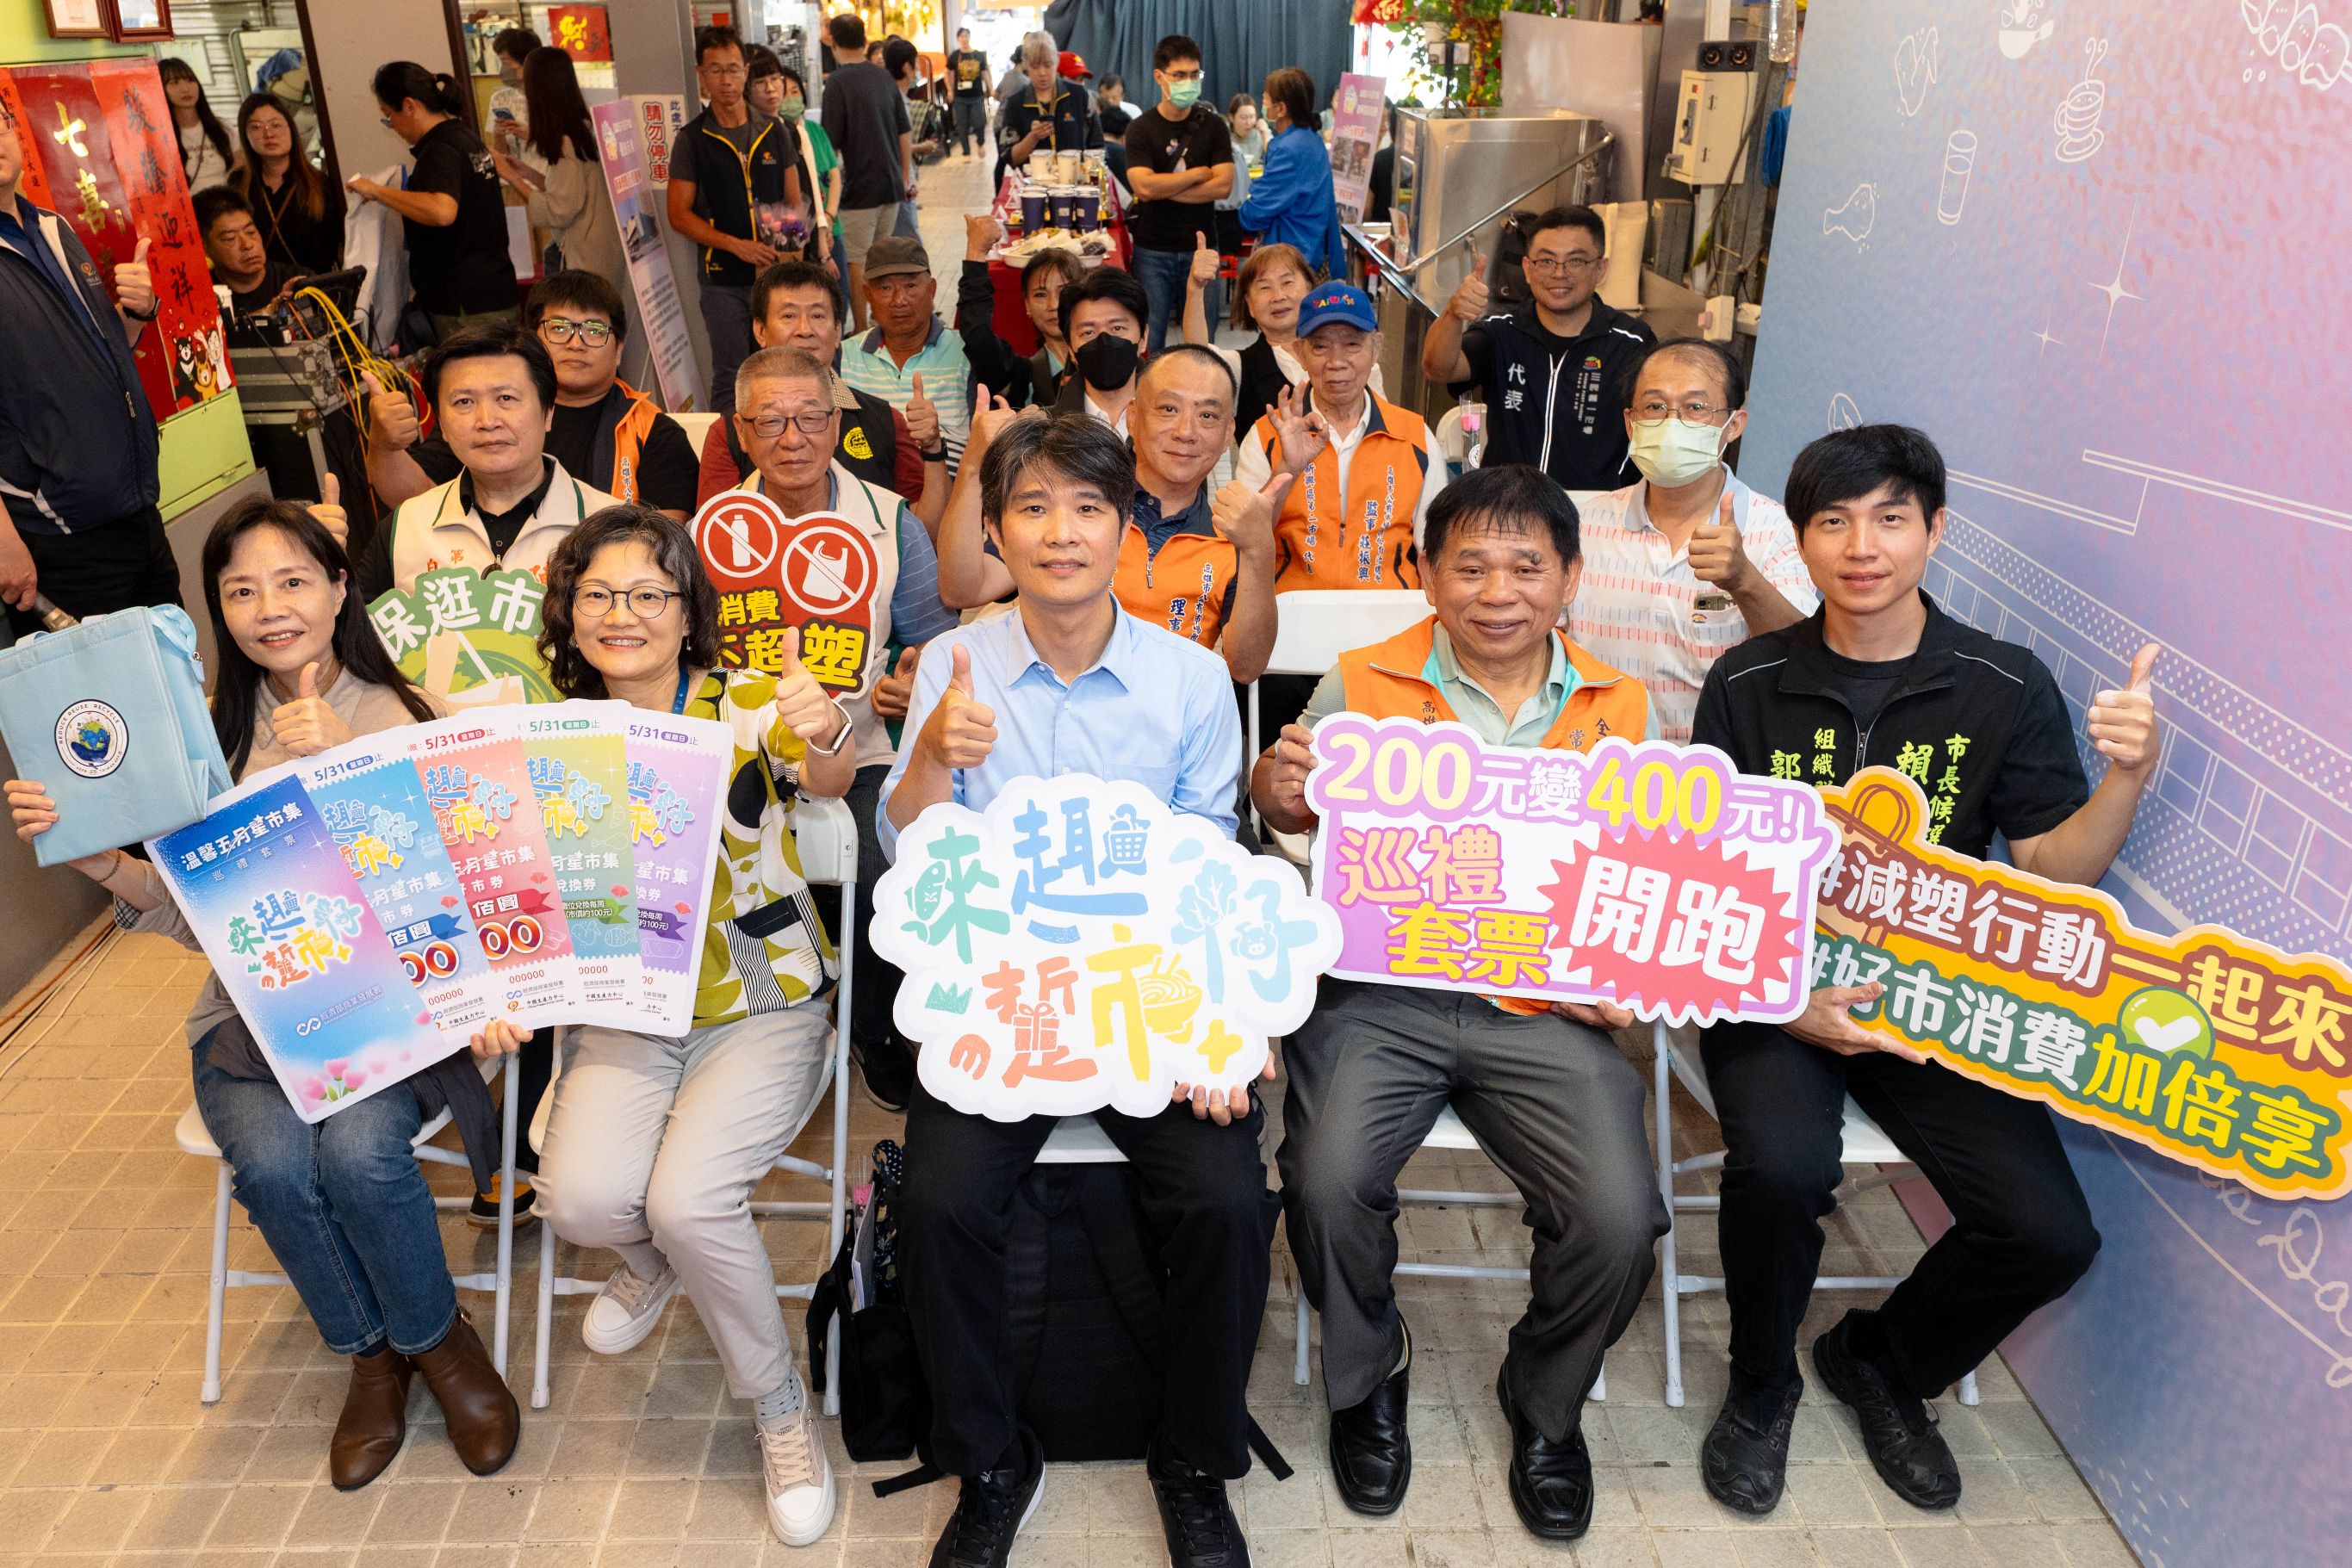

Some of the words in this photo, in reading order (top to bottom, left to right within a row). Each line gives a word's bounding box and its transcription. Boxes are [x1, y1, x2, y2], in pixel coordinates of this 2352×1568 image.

[643, 103, 669, 181] 請勿停車
[1505, 363, 1526, 412] 代表
[1168, 598, 1187, 631] 理事
[59, 717, 68, 745] REDUCE
[68, 703, 88, 716] REUSE
[93, 703, 120, 724] RECYCLE
[1324, 732, 1795, 840] 200元變400元!
[1770, 749, 1802, 781] 郭
[1896, 741, 1934, 785] 賴
[1339, 826, 1505, 906] 巡禮
[1569, 855, 1766, 985] 開跑
[1388, 901, 1550, 986] 套票
[428, 988, 463, 1006] 000000
[509, 970, 545, 984] 000000
